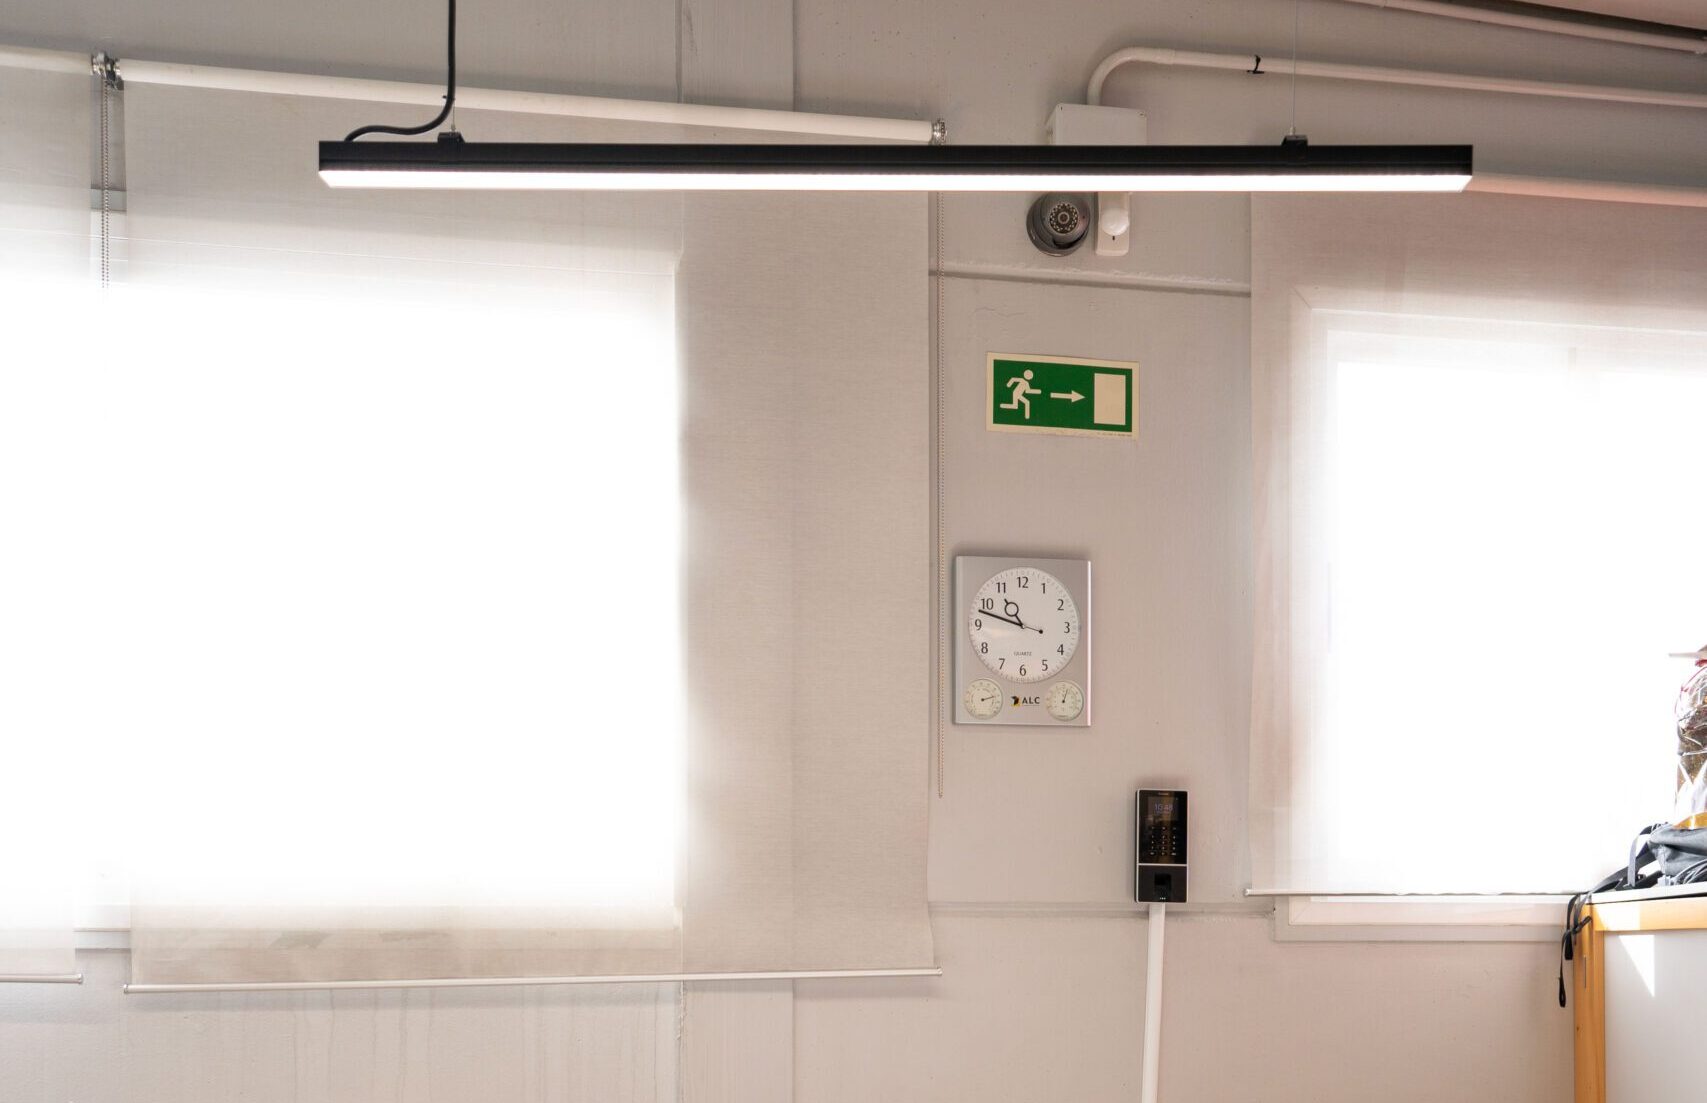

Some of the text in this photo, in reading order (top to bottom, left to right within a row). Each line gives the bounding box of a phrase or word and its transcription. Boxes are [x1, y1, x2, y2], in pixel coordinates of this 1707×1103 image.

[996, 582, 1006, 593] 11
[1016, 576, 1029, 588] 12
[1041, 582, 1046, 594] 1
[980, 598, 994, 610] 10
[1057, 599, 1064, 611] 2
[974, 619, 982, 631] 9
[1063, 622, 1071, 633] 3
[981, 642, 989, 654] 8
[1056, 644, 1065, 656] 4
[998, 658, 1005, 670] 7
[1019, 664, 1027, 676] 6
[1041, 659, 1048, 671] 5
[1022, 696, 1040, 705] ALC
